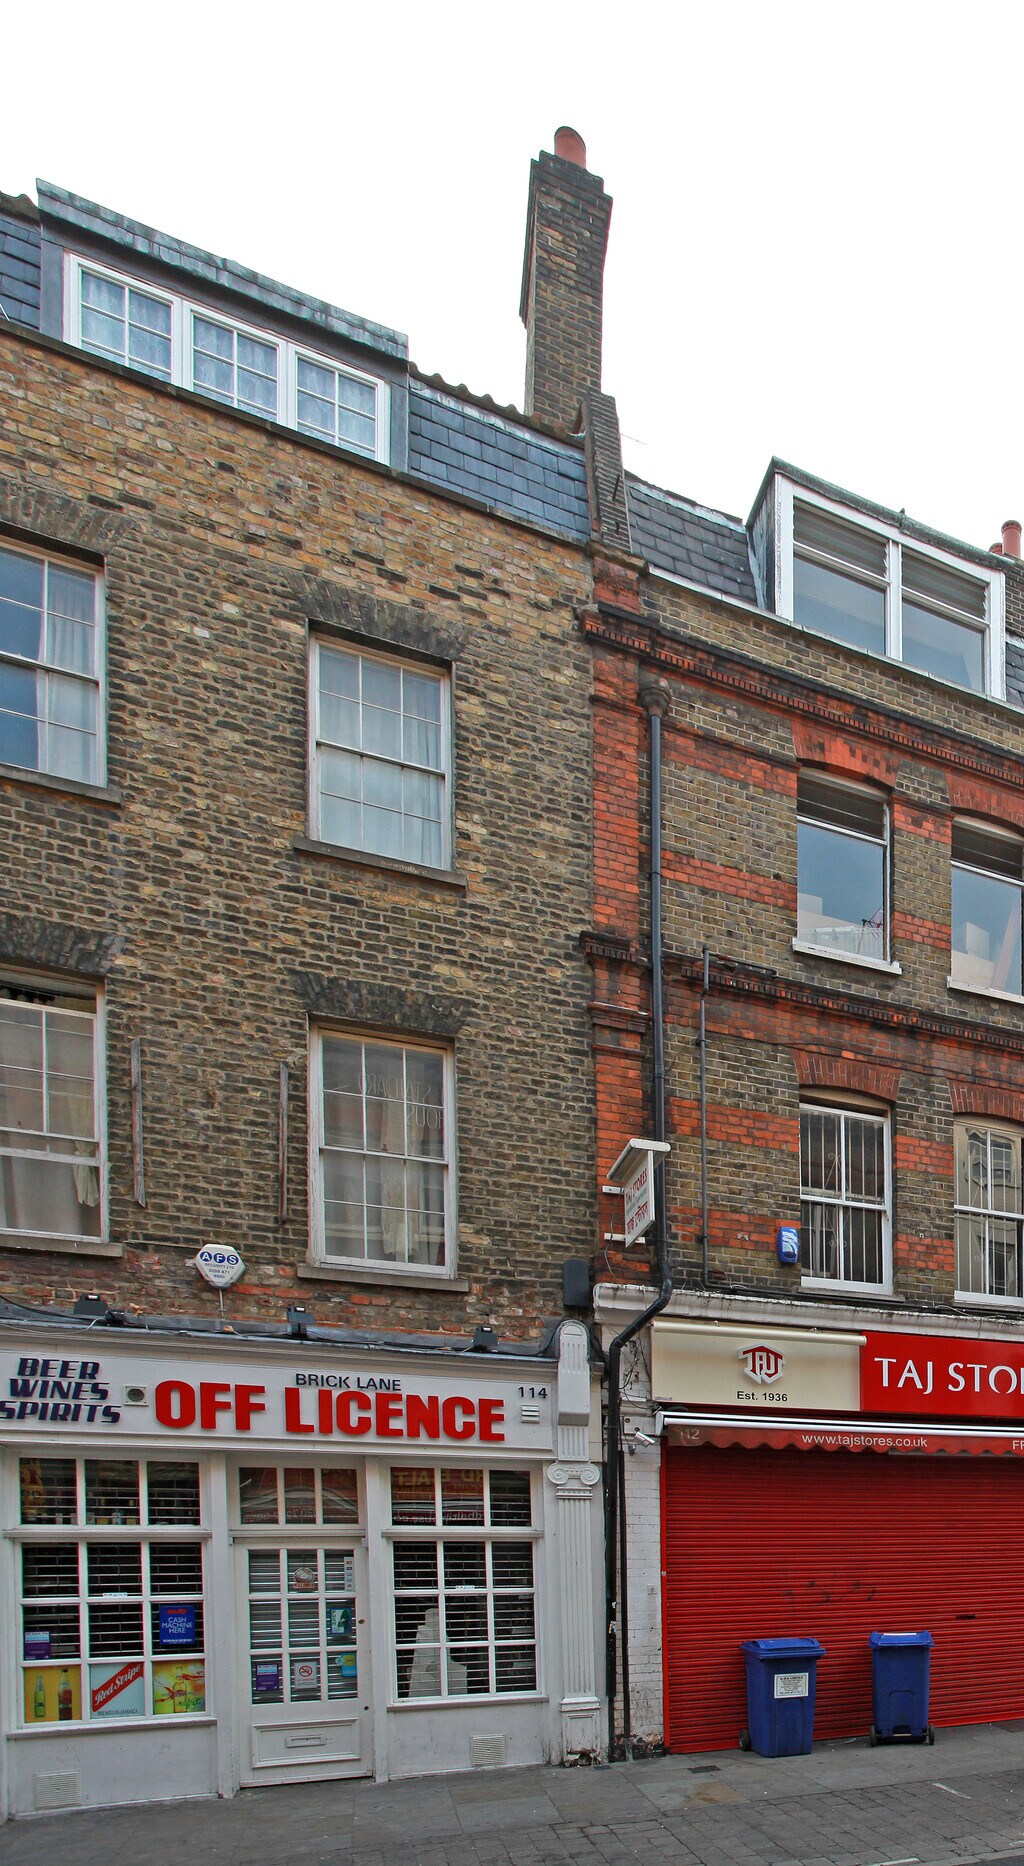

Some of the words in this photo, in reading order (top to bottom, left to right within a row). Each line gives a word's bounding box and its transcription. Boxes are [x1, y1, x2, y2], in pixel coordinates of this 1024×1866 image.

[201, 1252, 238, 1265] AFS
[17, 1357, 101, 1380] BEER
[873, 1357, 934, 1395] TAJ
[9, 1378, 110, 1401] WINES
[295, 1373, 350, 1389] BRICK
[356, 1377, 402, 1391] LANE
[517, 1386, 548, 1399] 114
[736, 1391, 759, 1401] Est.
[762, 1392, 788, 1402] 1936
[0, 1401, 122, 1424] SPIRITS
[155, 1379, 266, 1430] OFF
[284, 1386, 506, 1442] LICENCE
[680, 1428, 700, 1441] 112
[801, 1434, 928, 1448] www.tajstores.co.uk
[95, 1683, 115, 1706] Red
[114, 1664, 141, 1690] Stripe
